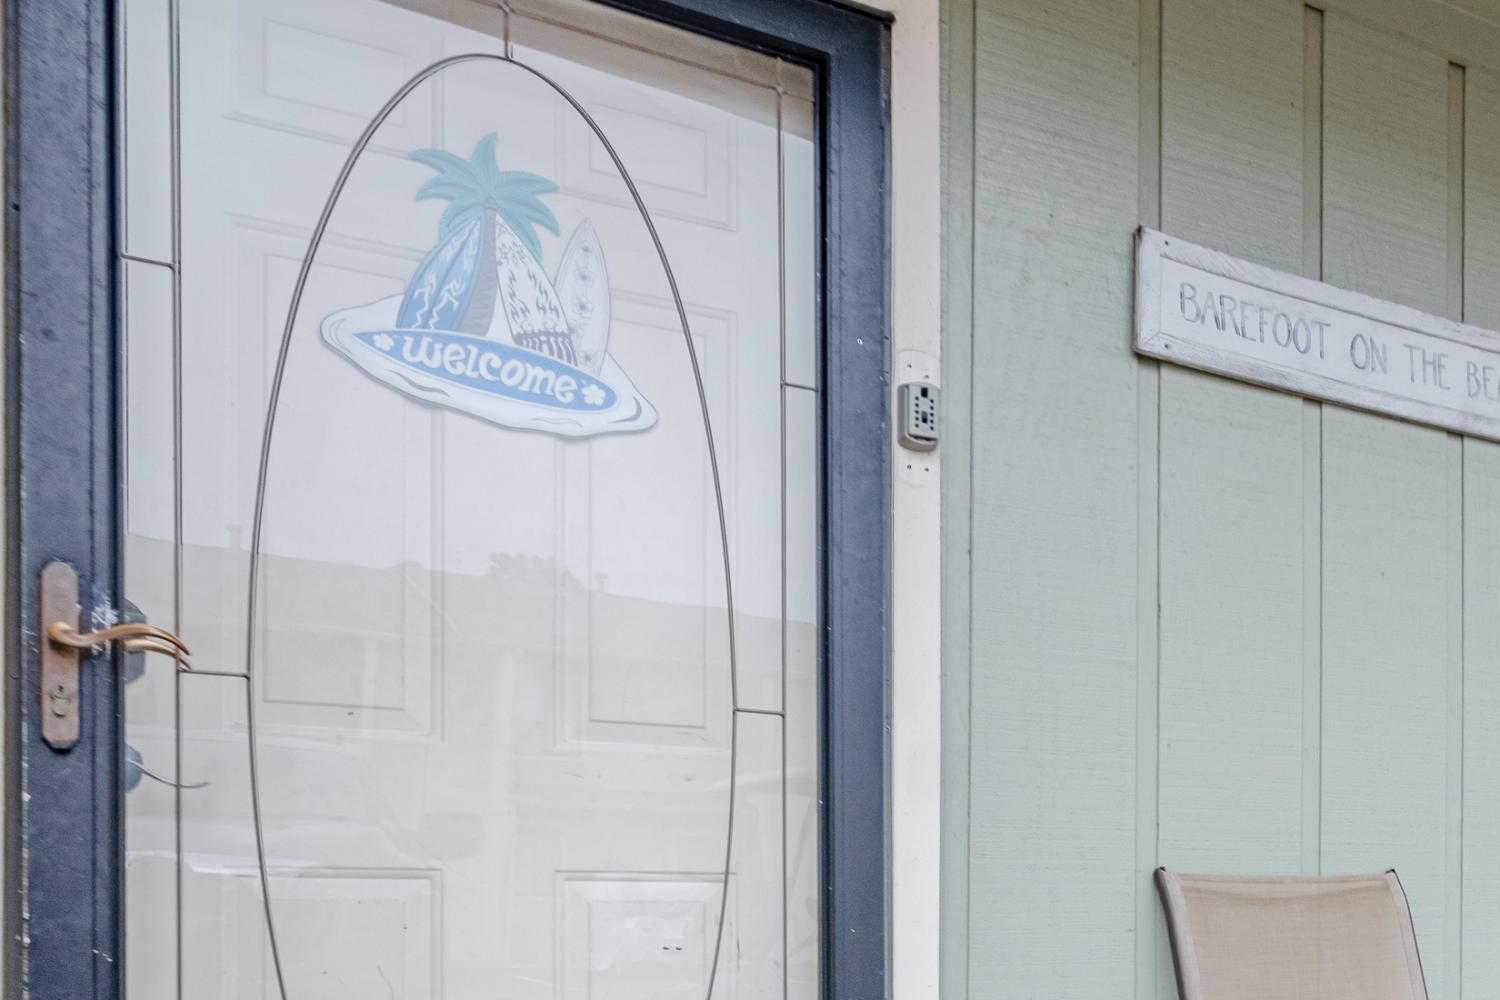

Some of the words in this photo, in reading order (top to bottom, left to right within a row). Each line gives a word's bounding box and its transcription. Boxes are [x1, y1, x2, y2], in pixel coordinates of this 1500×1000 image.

[1179, 282, 1330, 360] BAREFOOT
[1349, 333, 1388, 375] ON
[1403, 343, 1451, 390] THE
